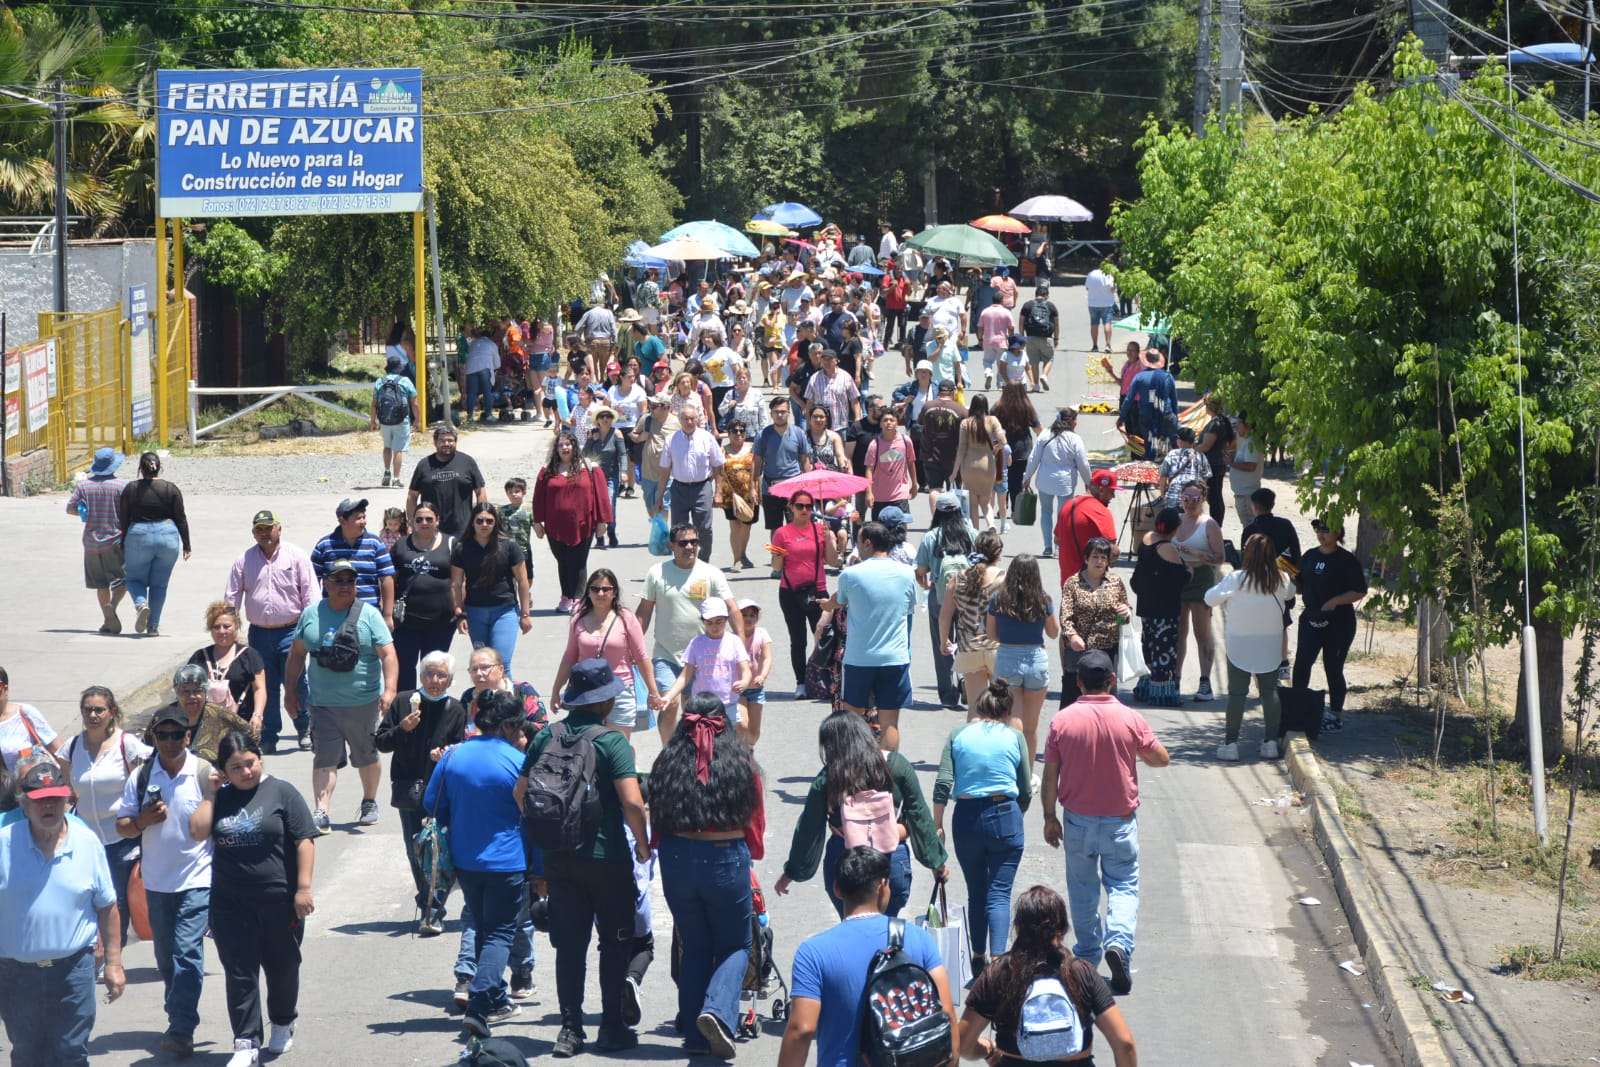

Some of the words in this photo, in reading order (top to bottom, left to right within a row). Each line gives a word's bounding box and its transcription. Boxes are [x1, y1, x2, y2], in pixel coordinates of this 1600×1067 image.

[168, 76, 359, 109] FERRETERÍA
[168, 119, 229, 146] PAN
[240, 118, 280, 145] DE
[288, 117, 415, 144] AZUCAR
[221, 152, 242, 169] Lo
[247, 151, 300, 168] Nuevo
[304, 154, 343, 171] para
[348, 150, 364, 166] la
[182, 172, 295, 190] Construcción
[301, 171, 322, 188] de
[327, 175, 347, 187] su
[352, 170, 404, 190] Hogar
[202, 199, 234, 213] Fonos:
[236, 198, 259, 214] (072)
